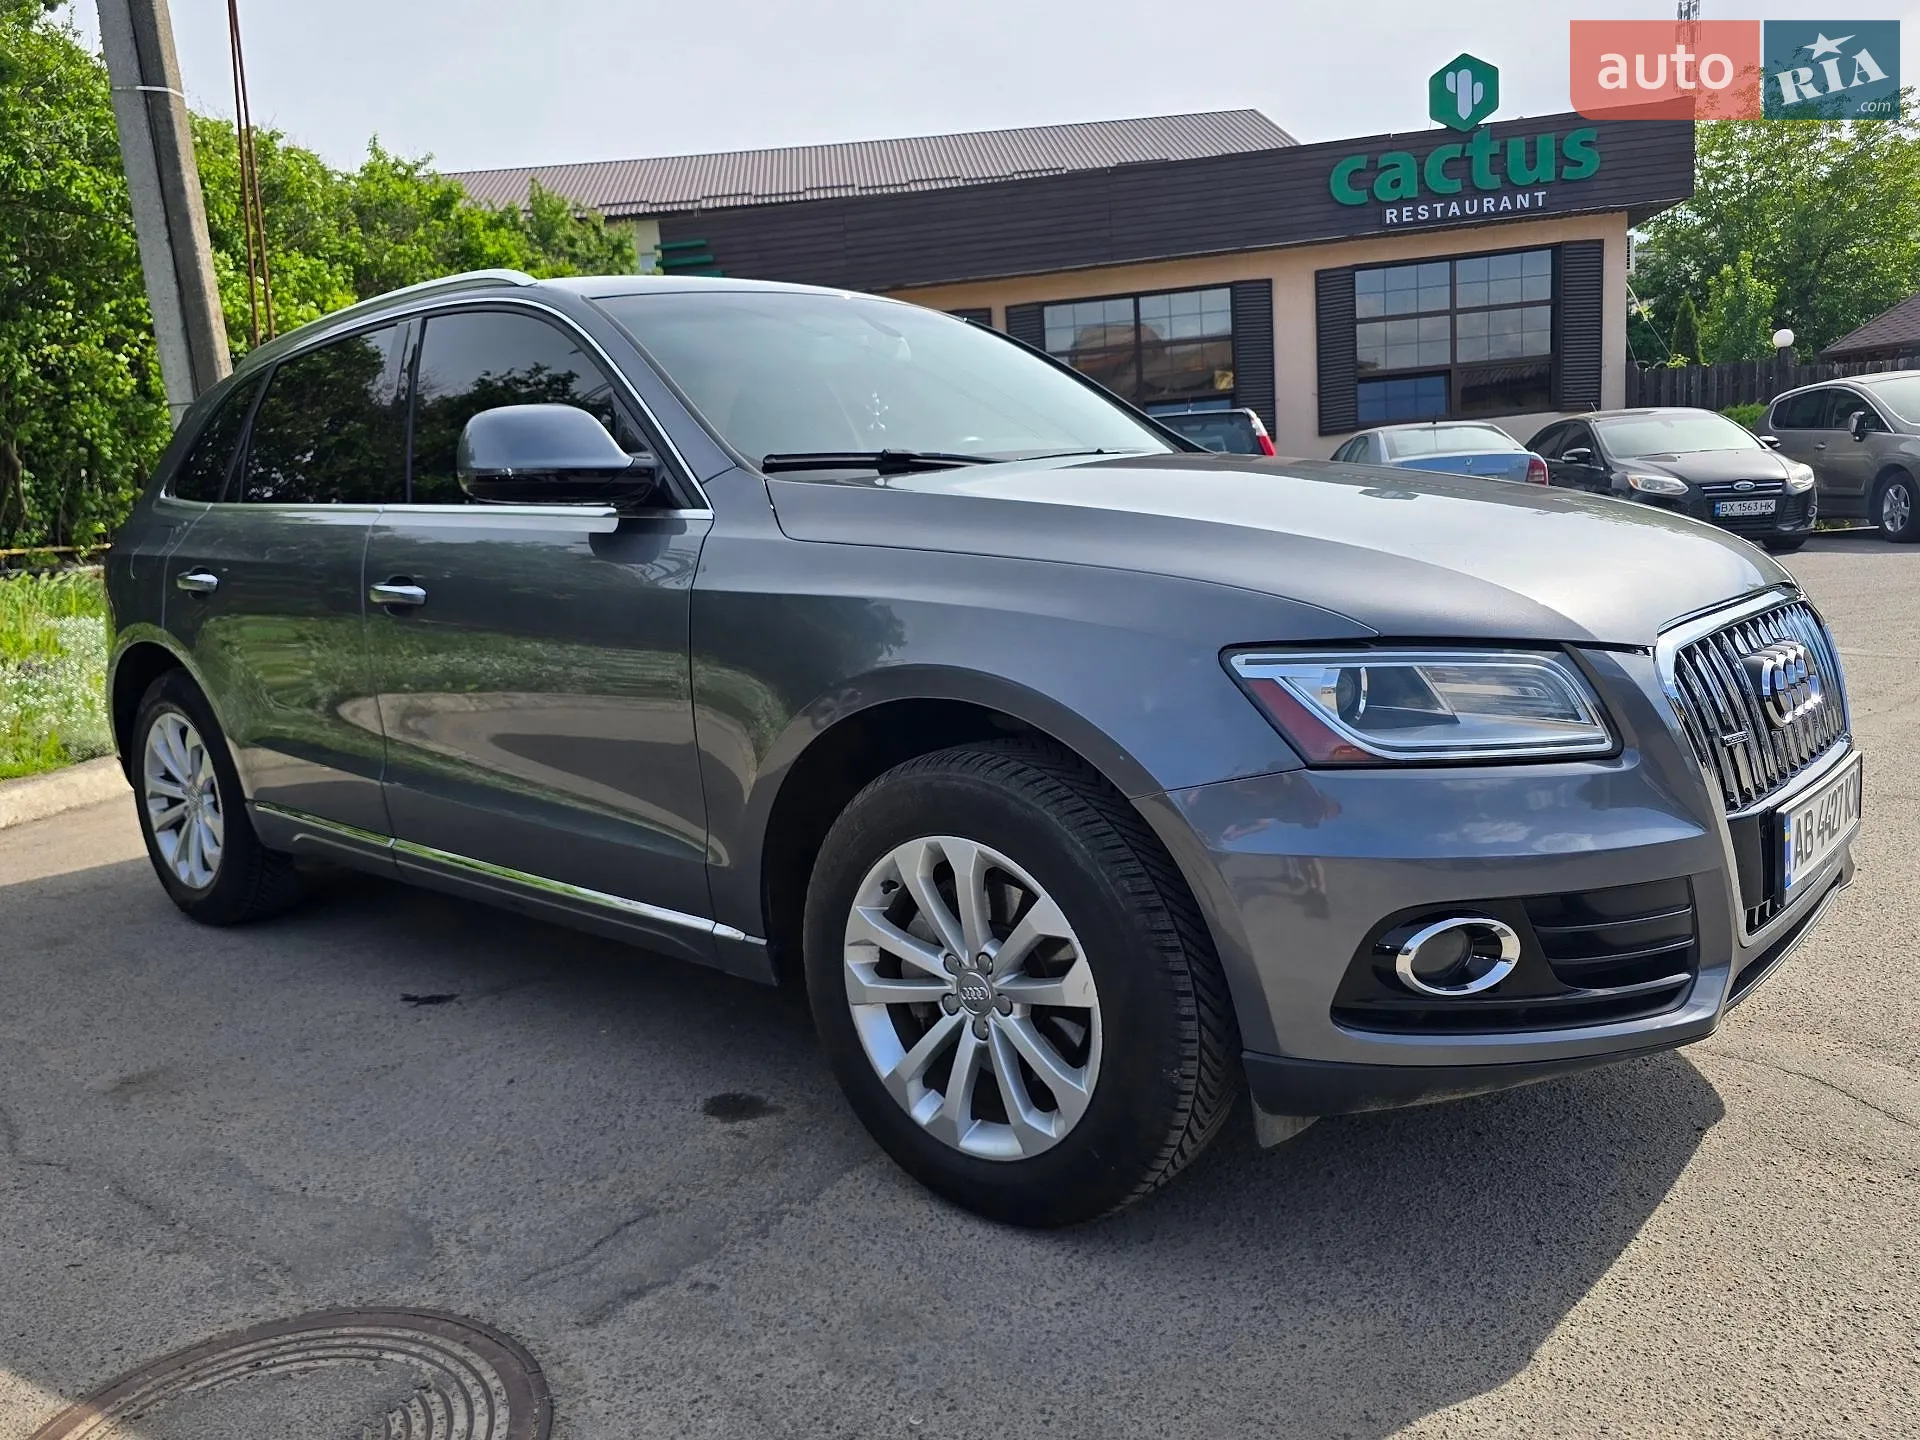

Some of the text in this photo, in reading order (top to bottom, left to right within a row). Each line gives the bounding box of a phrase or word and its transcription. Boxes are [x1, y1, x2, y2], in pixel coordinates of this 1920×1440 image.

[1329, 126, 1601, 206] cactus
[1385, 191, 1547, 224] RESTAURANT
[1721, 501, 1774, 513] BX 1563 HK
[1793, 809, 1814, 872] AB
[1817, 783, 1844, 848] 4427
